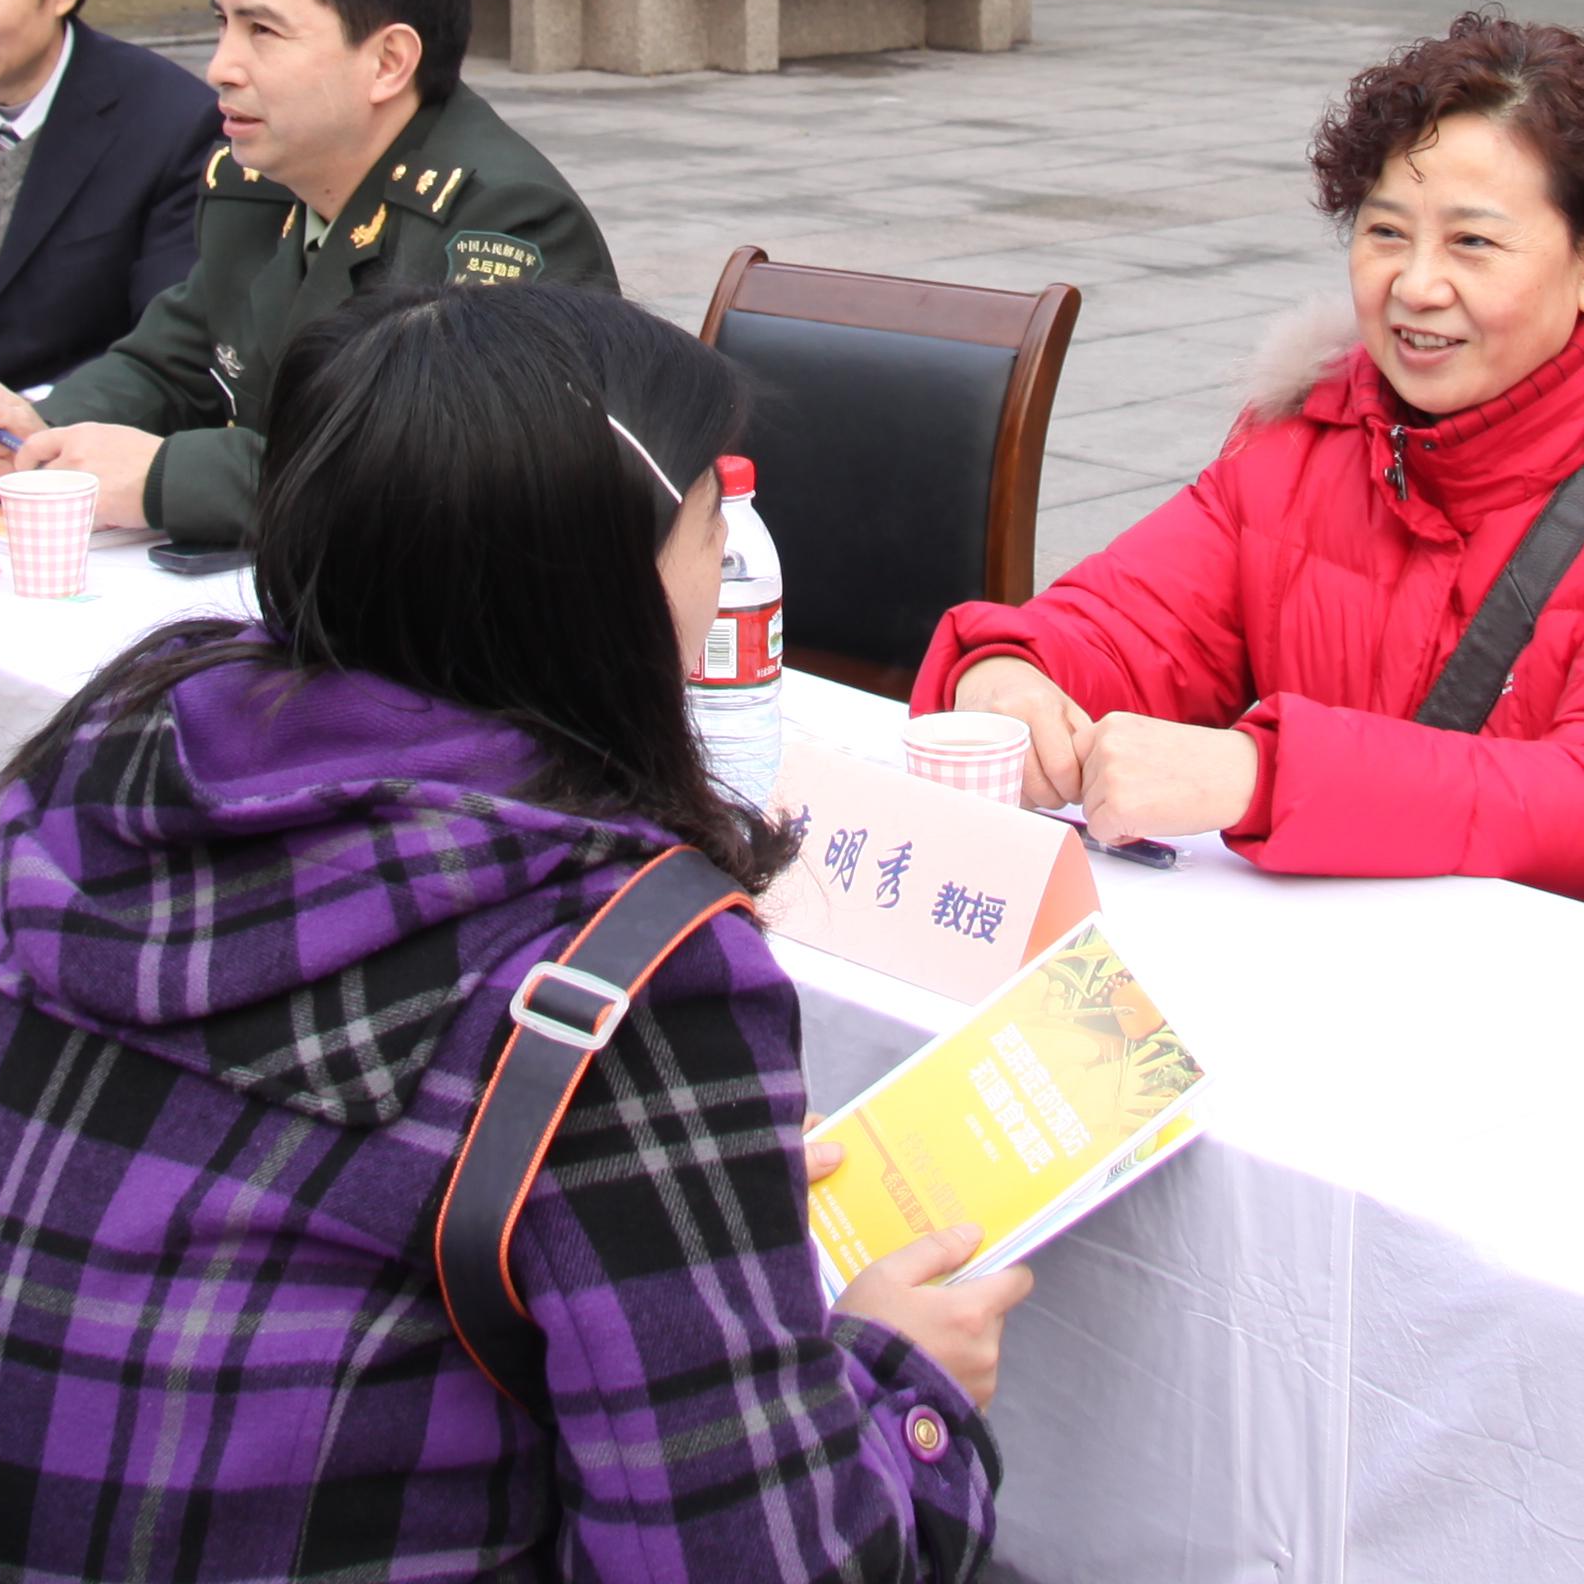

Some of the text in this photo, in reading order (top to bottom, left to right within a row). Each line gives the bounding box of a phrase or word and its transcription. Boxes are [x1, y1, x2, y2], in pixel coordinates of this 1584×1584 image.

[456, 240, 537, 267] 中国人民解放军
[466, 256, 521, 278] 总后勤部
[930, 879, 1008, 945] 教授
